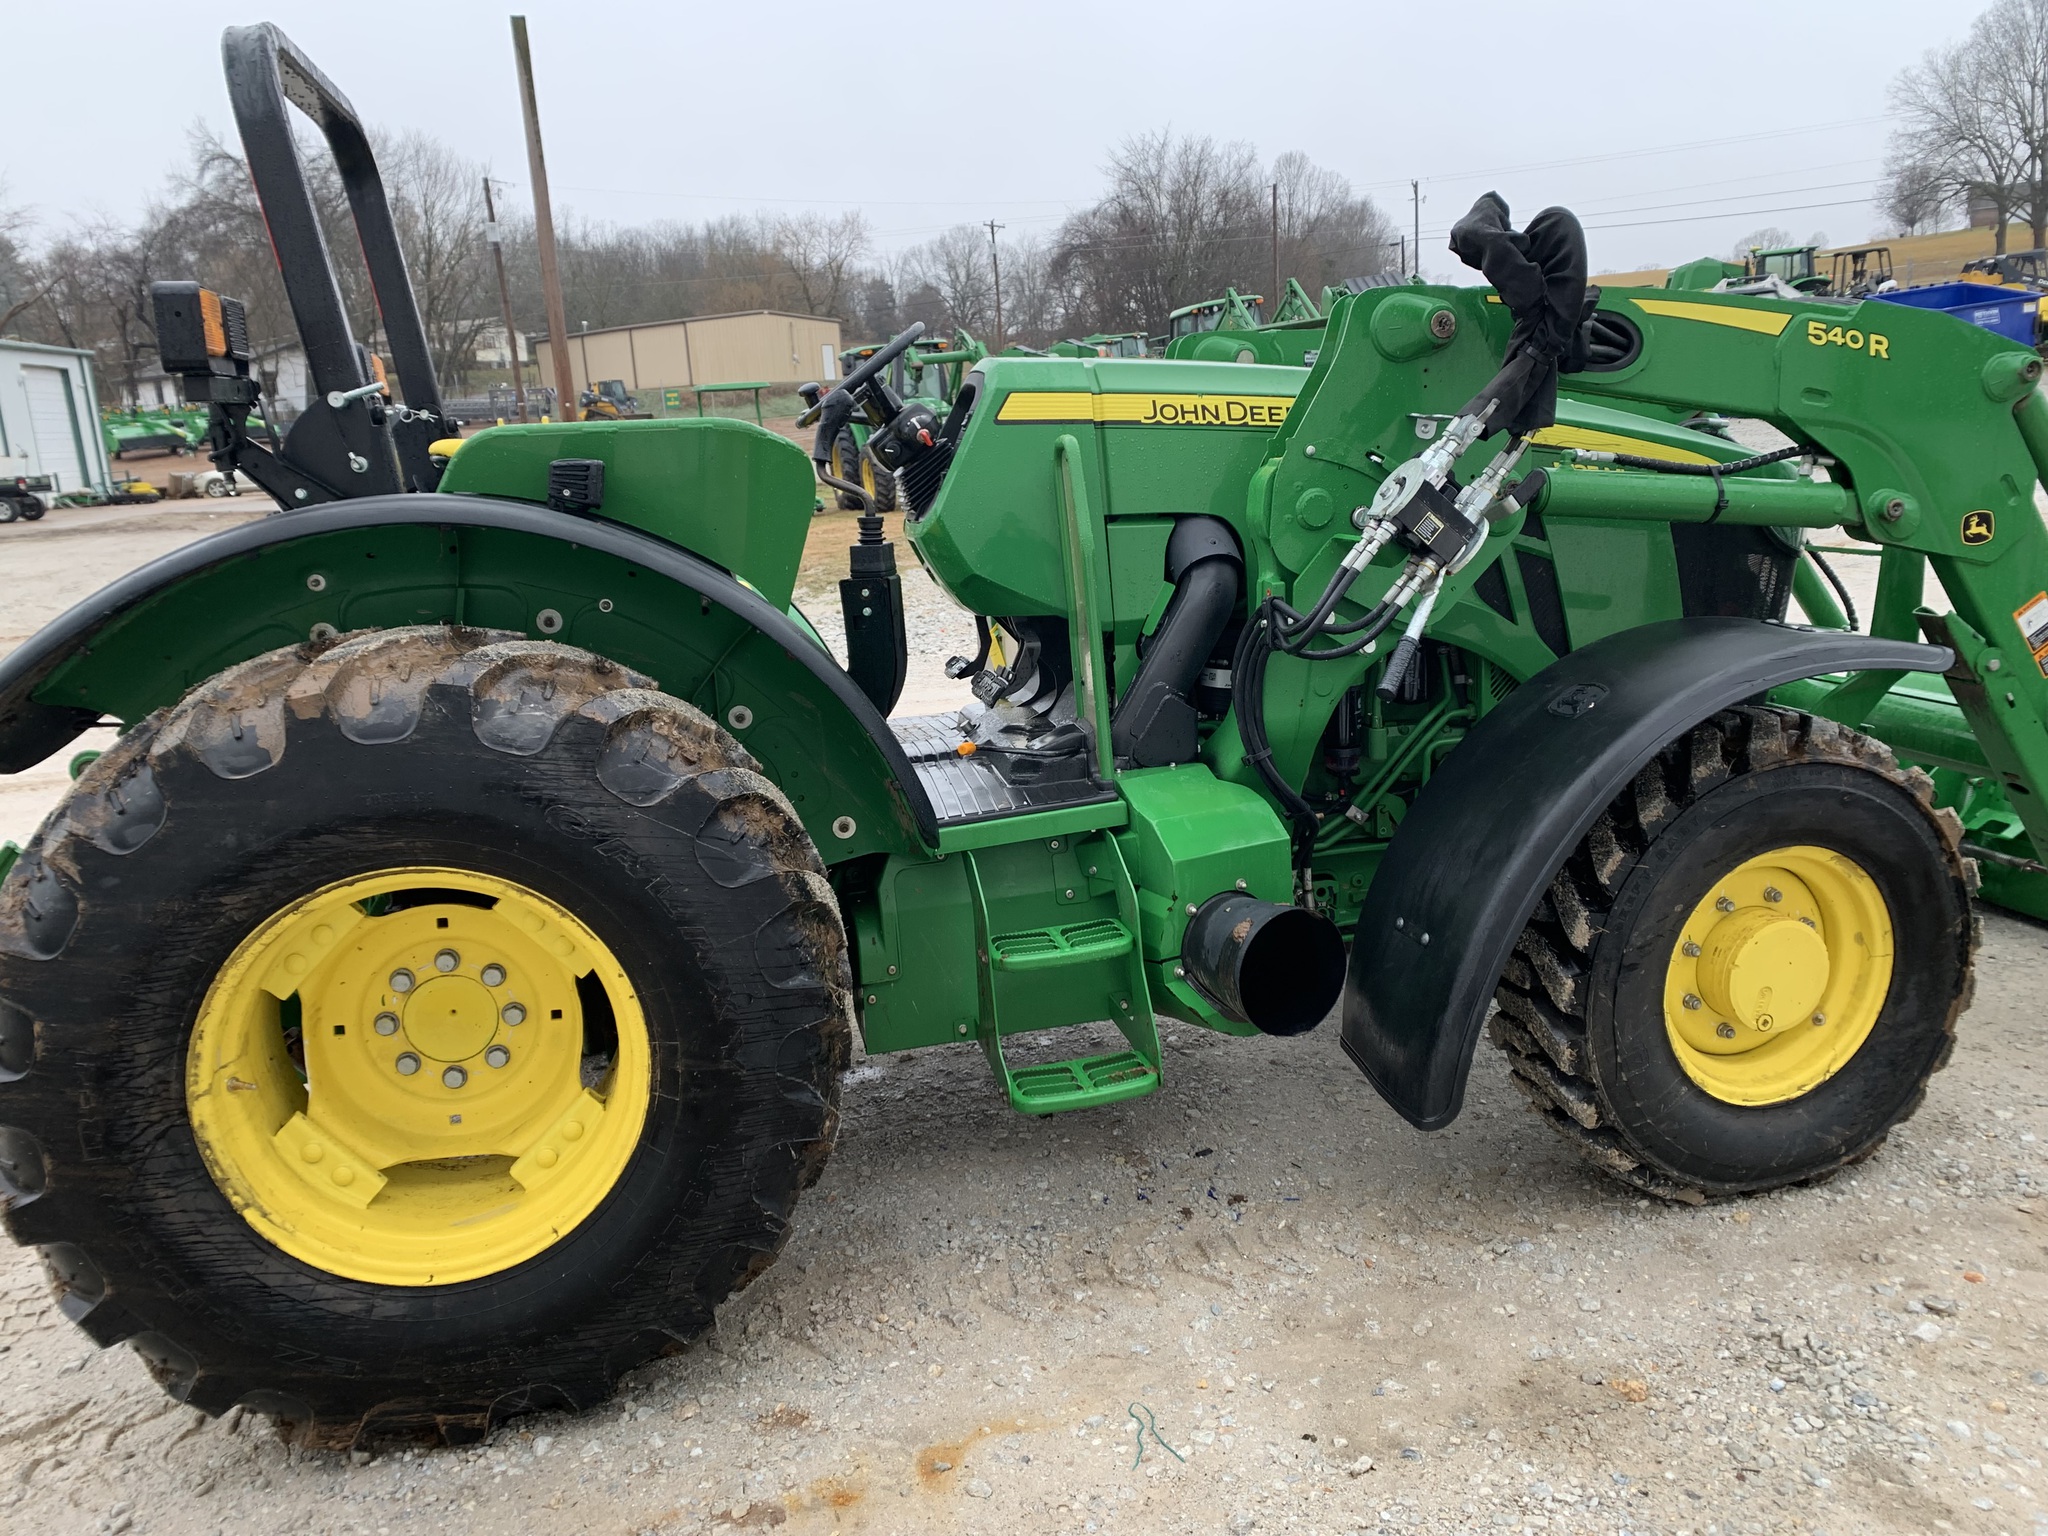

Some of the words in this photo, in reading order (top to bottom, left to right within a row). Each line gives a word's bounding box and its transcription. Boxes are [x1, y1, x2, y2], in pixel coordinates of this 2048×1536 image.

[1807, 320, 1865, 349] 540
[1869, 333, 1889, 359] R
[1143, 400, 1220, 422] JOHN
[1226, 401, 1291, 423] DEE
